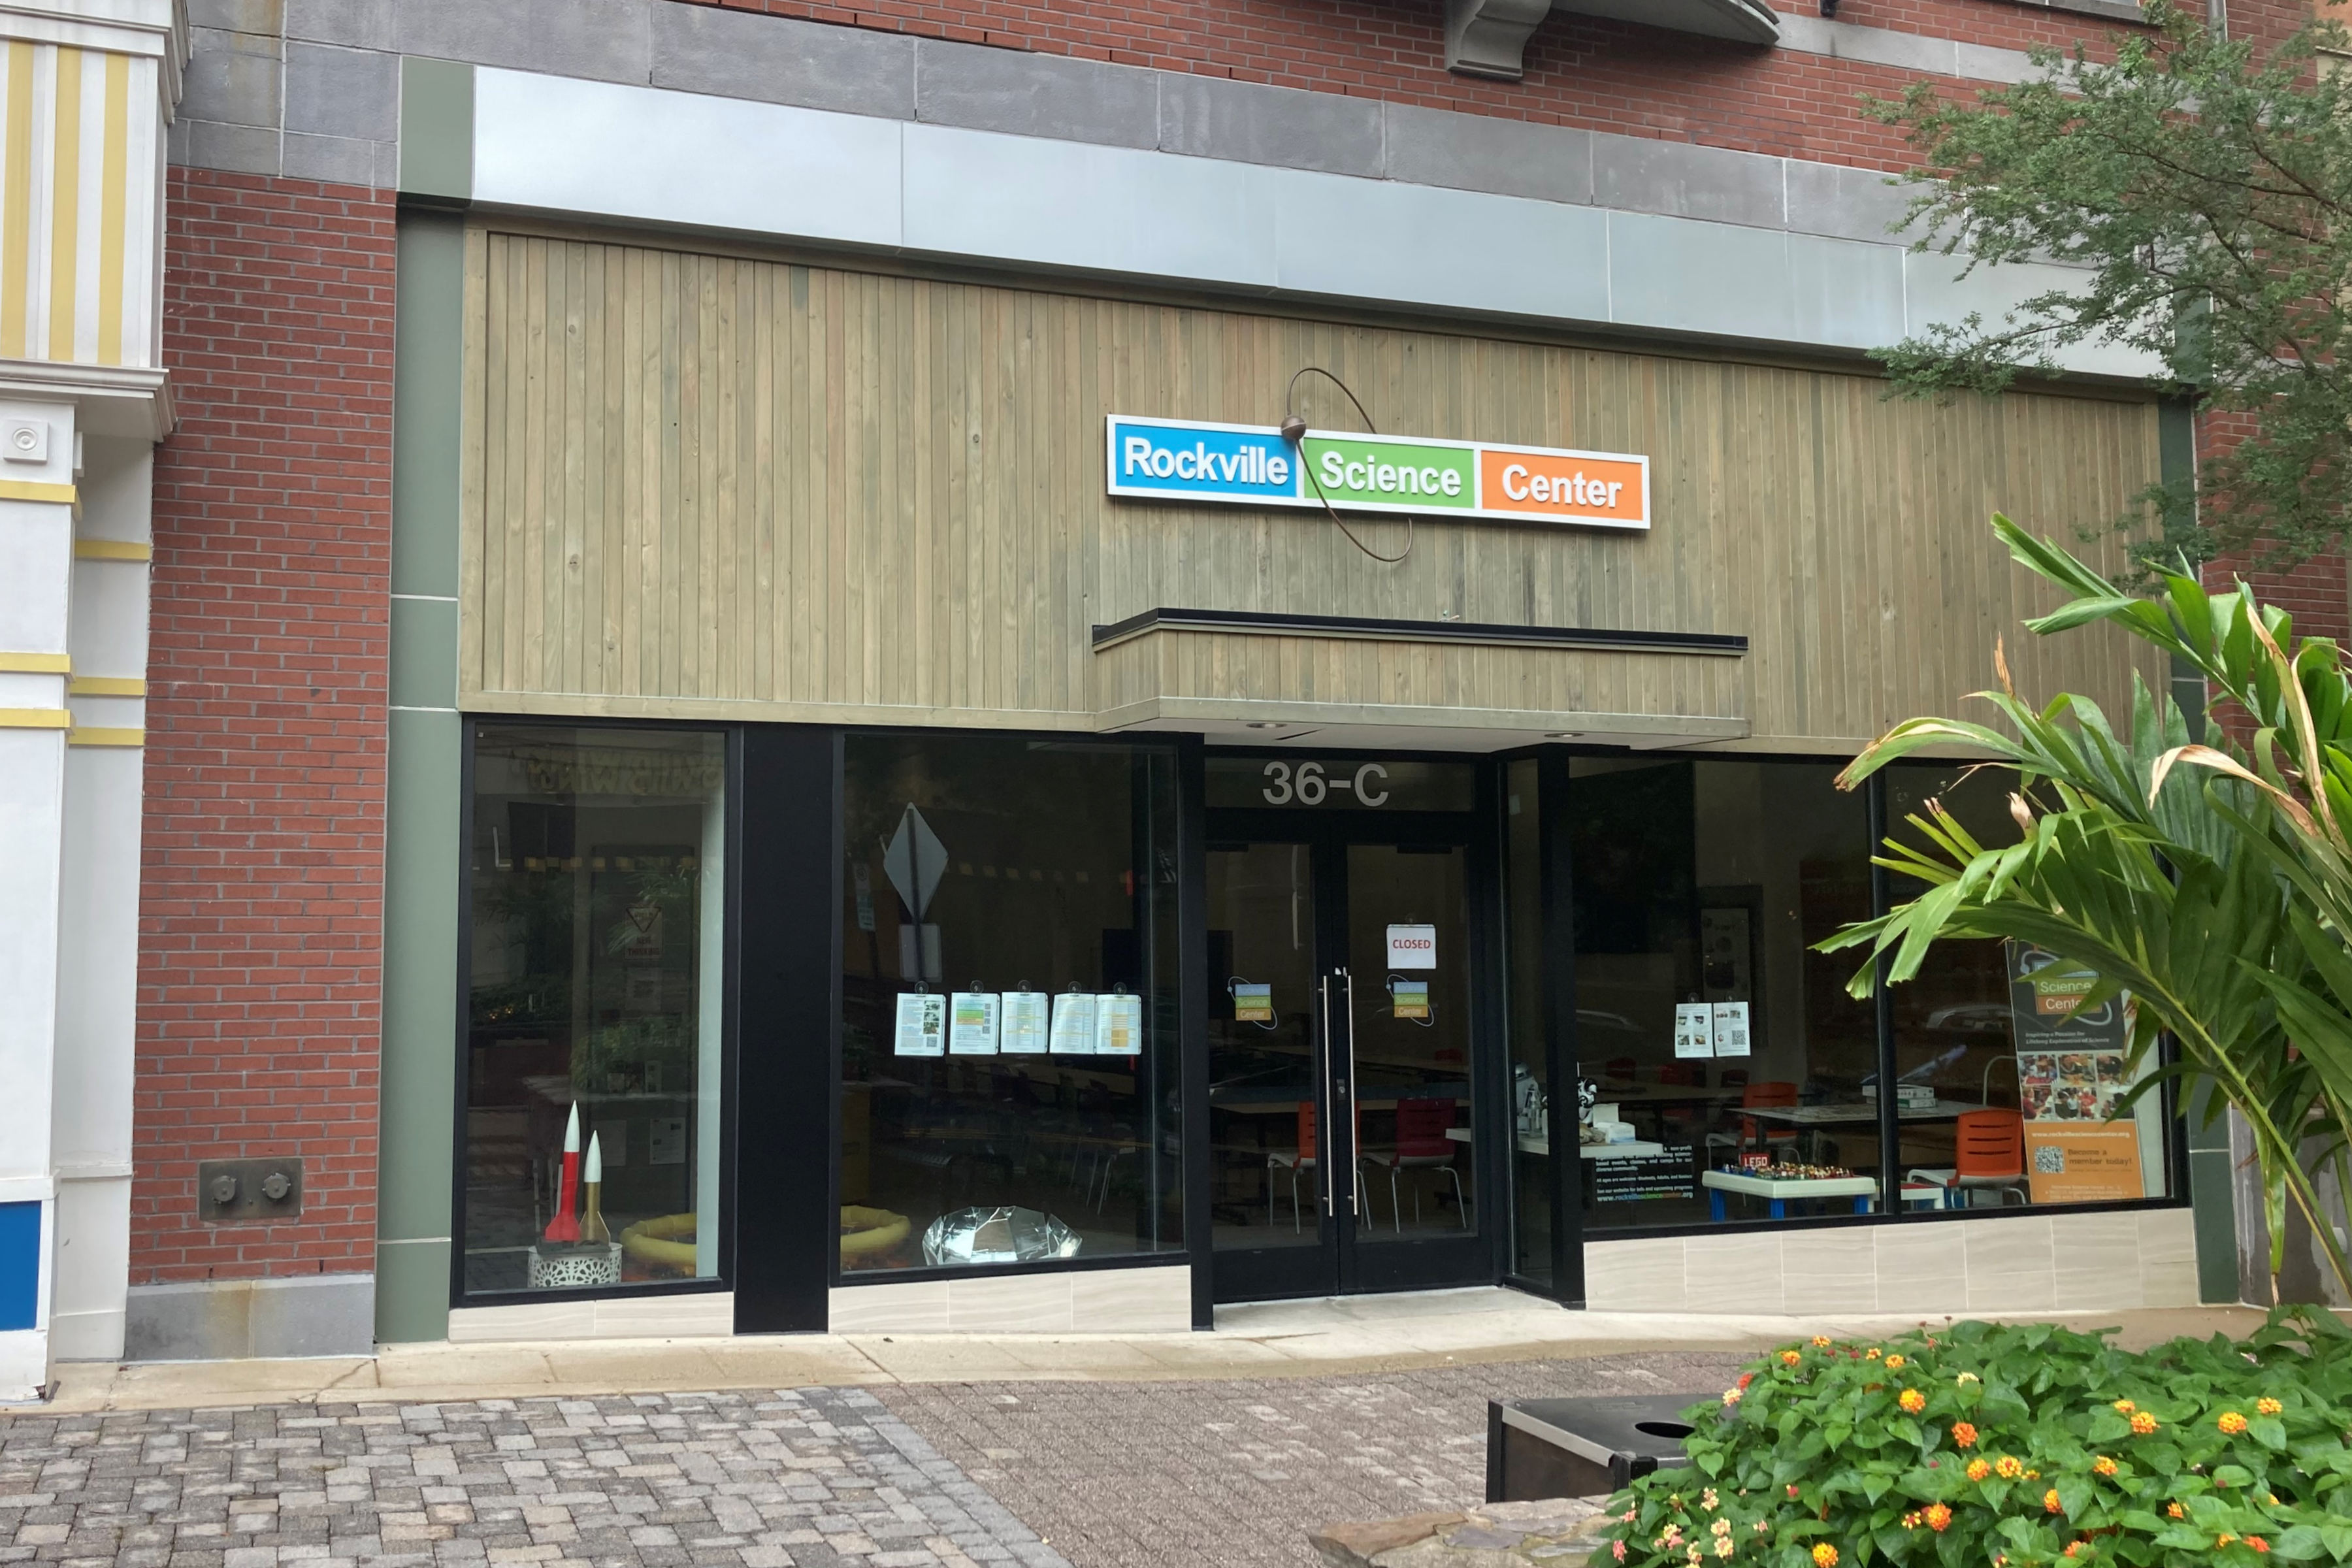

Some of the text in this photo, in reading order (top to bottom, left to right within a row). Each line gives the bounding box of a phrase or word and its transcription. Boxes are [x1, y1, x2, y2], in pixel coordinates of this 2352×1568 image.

[1124, 436, 1623, 508] Rockville Science Center
[1262, 761, 1389, 807] 36-C
[1392, 939, 1431, 949] CLOSED
[1237, 998, 1267, 1007] Science
[1395, 996, 1424, 1004] Science
[1240, 1009, 1266, 1019] Center
[1744, 1156, 1768, 1167] LEGO
[2106, 1158, 2132, 1166] today!
